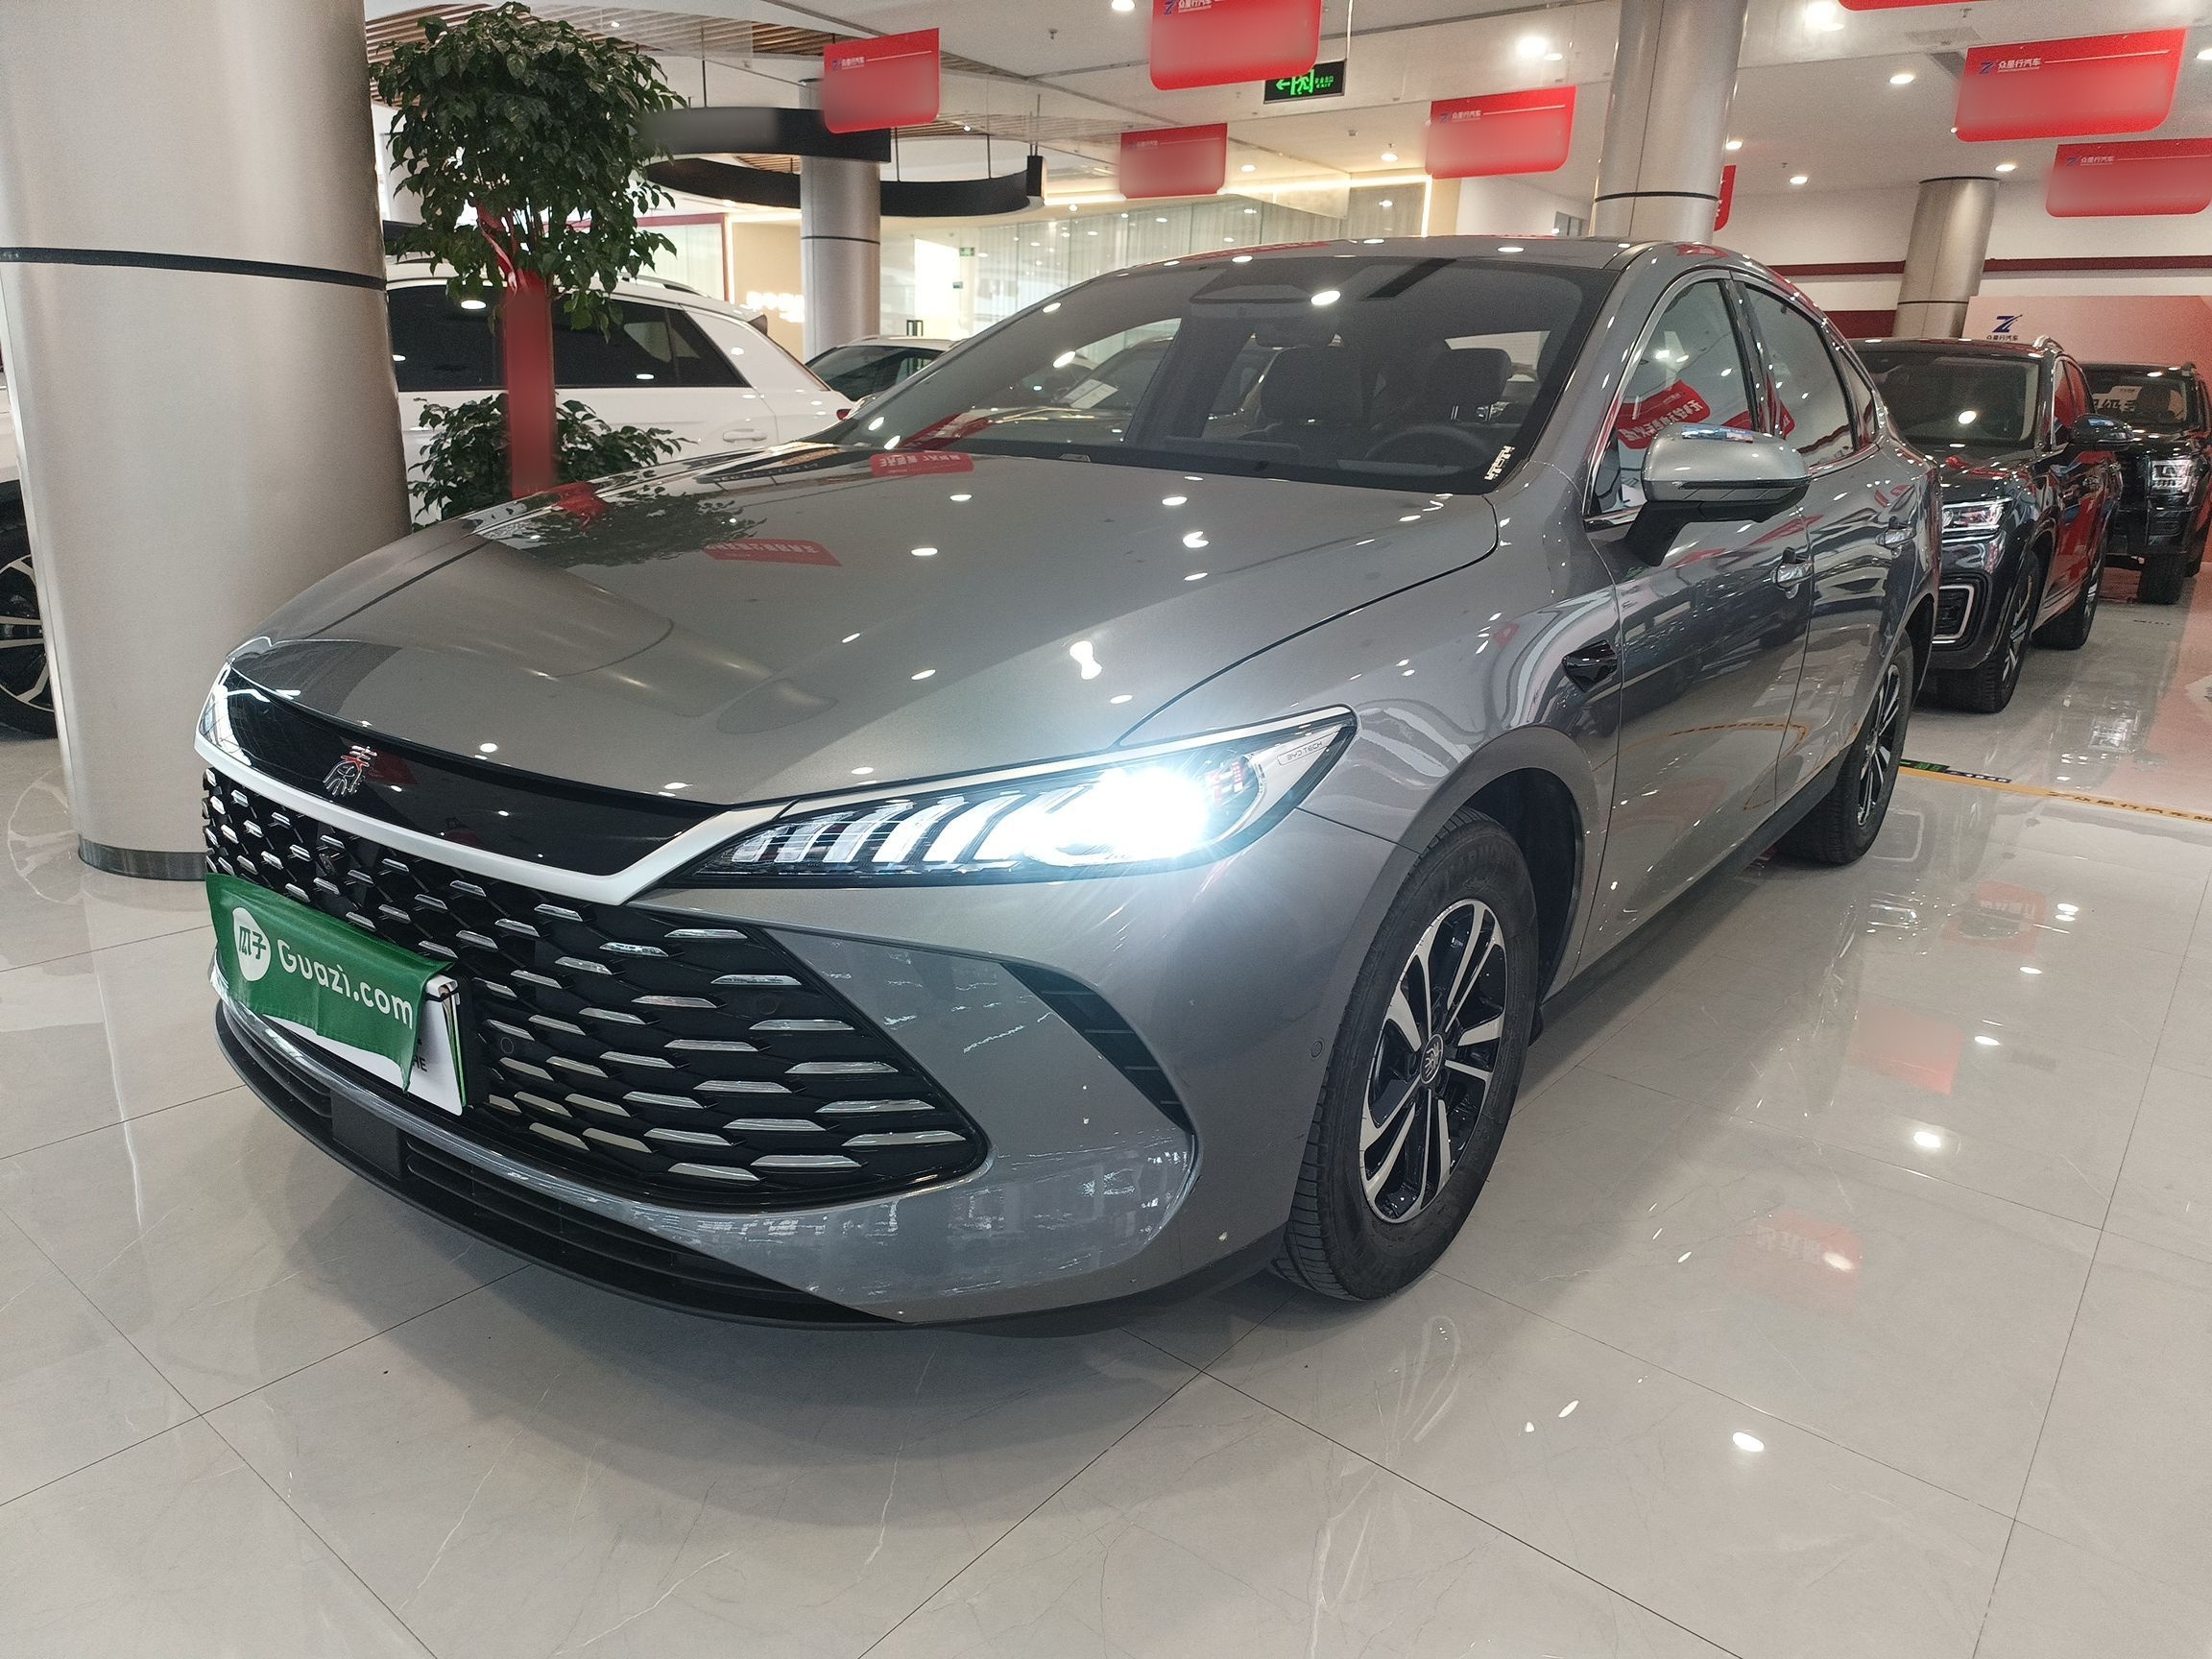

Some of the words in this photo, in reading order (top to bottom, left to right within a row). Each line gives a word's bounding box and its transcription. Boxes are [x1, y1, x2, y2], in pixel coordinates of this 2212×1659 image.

[1998, 58, 2041, 69] 众星行汽车
[1286, 750, 1302, 760] BYD
[1303, 741, 1323, 753] TECH
